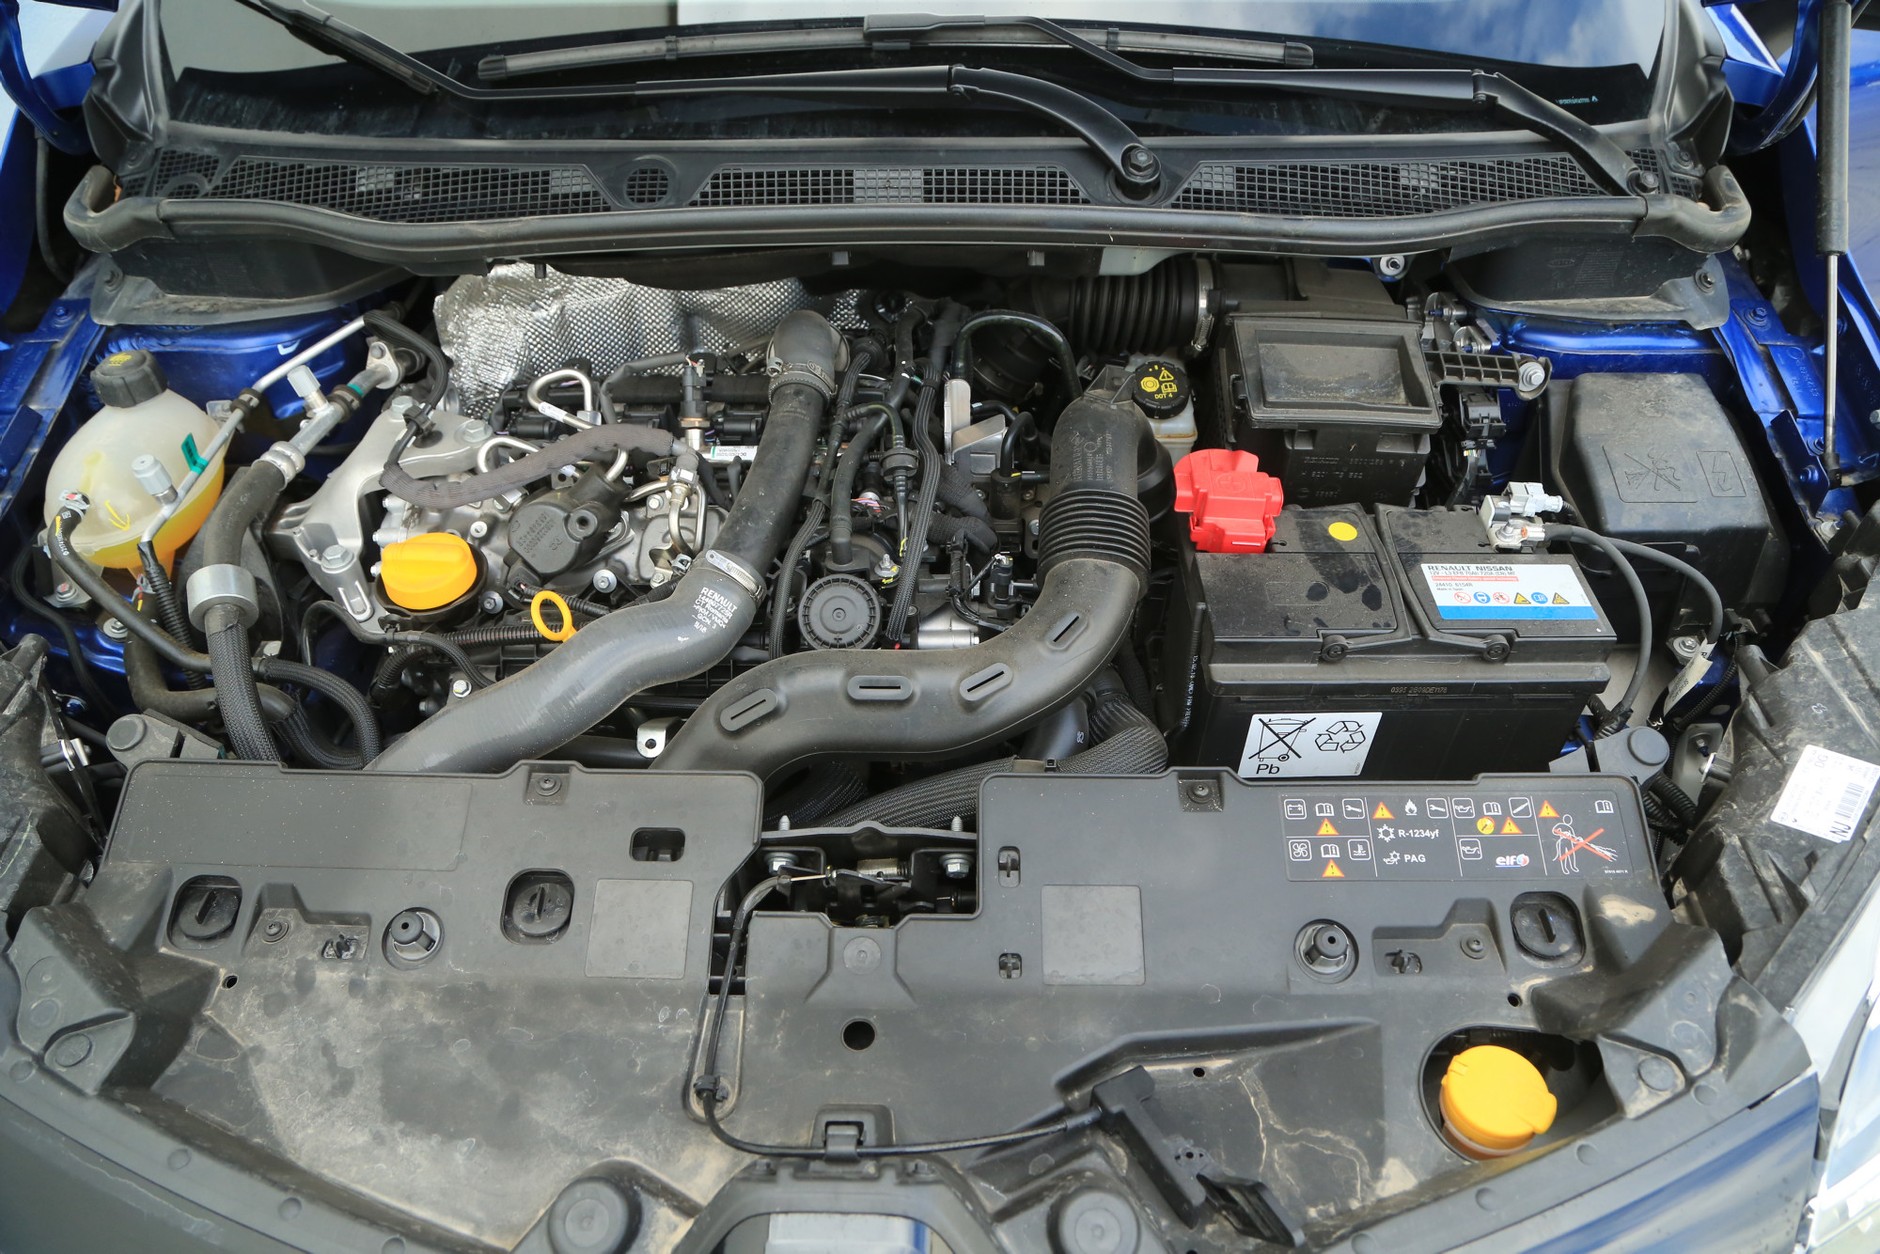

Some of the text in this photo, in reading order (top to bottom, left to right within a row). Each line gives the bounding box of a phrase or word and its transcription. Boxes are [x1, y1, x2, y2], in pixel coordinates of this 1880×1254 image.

[700, 586, 738, 613] RENAULT
[1256, 763, 1280, 775] Pb
[1398, 829, 1440, 839] R-1234yf
[1404, 854, 1426, 863] PAG
[1495, 854, 1518, 866] elf
